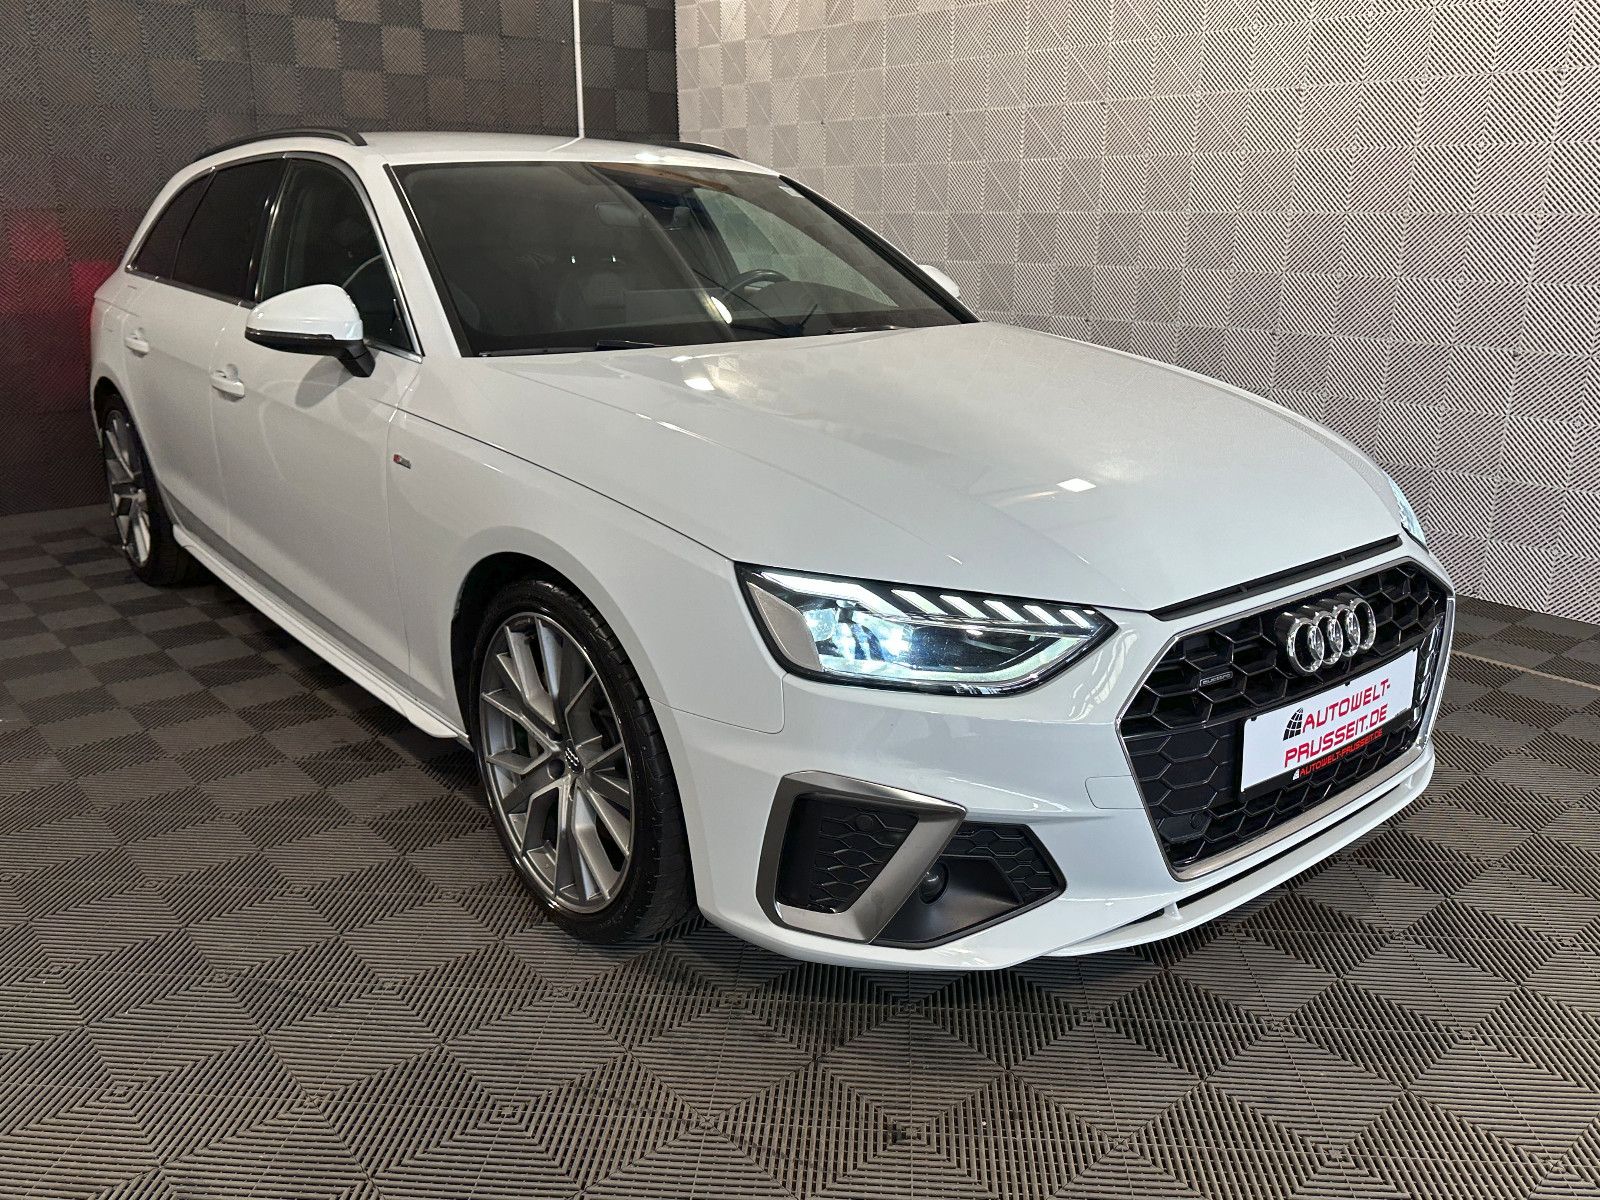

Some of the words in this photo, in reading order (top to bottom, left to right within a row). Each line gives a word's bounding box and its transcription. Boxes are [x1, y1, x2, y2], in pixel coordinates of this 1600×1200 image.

[1302, 678, 1391, 733] AUTOWELT-
[1284, 703, 1388, 768] PRUSSEIT.DE
[1299, 728, 1383, 777] AUTOWELT-PRUSSEIT.DE
